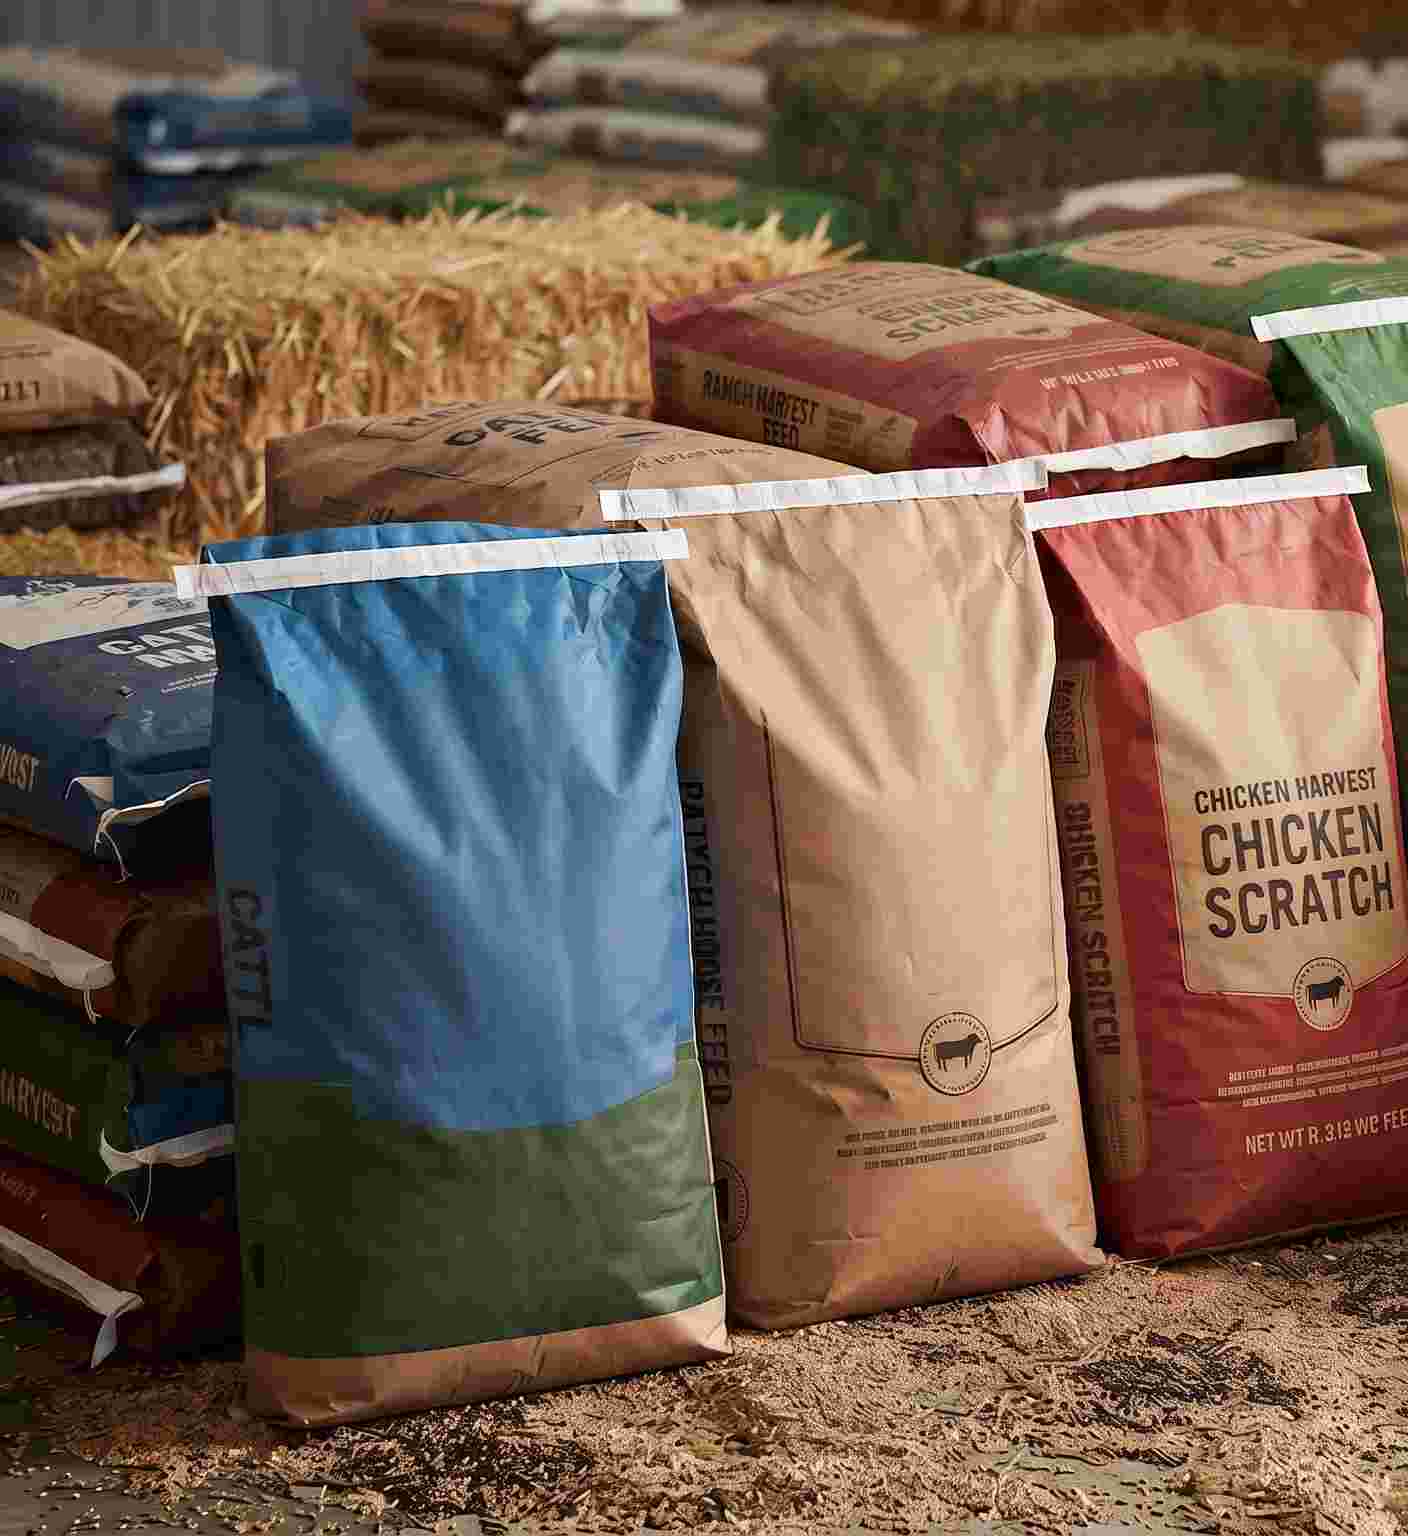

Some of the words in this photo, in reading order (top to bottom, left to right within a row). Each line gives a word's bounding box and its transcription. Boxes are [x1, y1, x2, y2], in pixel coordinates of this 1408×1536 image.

[1194, 779, 1290, 814] CHICKEN
[1295, 767, 1377, 800] HARVEST
[1201, 802, 1384, 875] CHICKEN
[1205, 861, 1394, 938] SCRATCH
[1246, 1132, 1275, 1155] NET
[1280, 1127, 1305, 1149] WT
